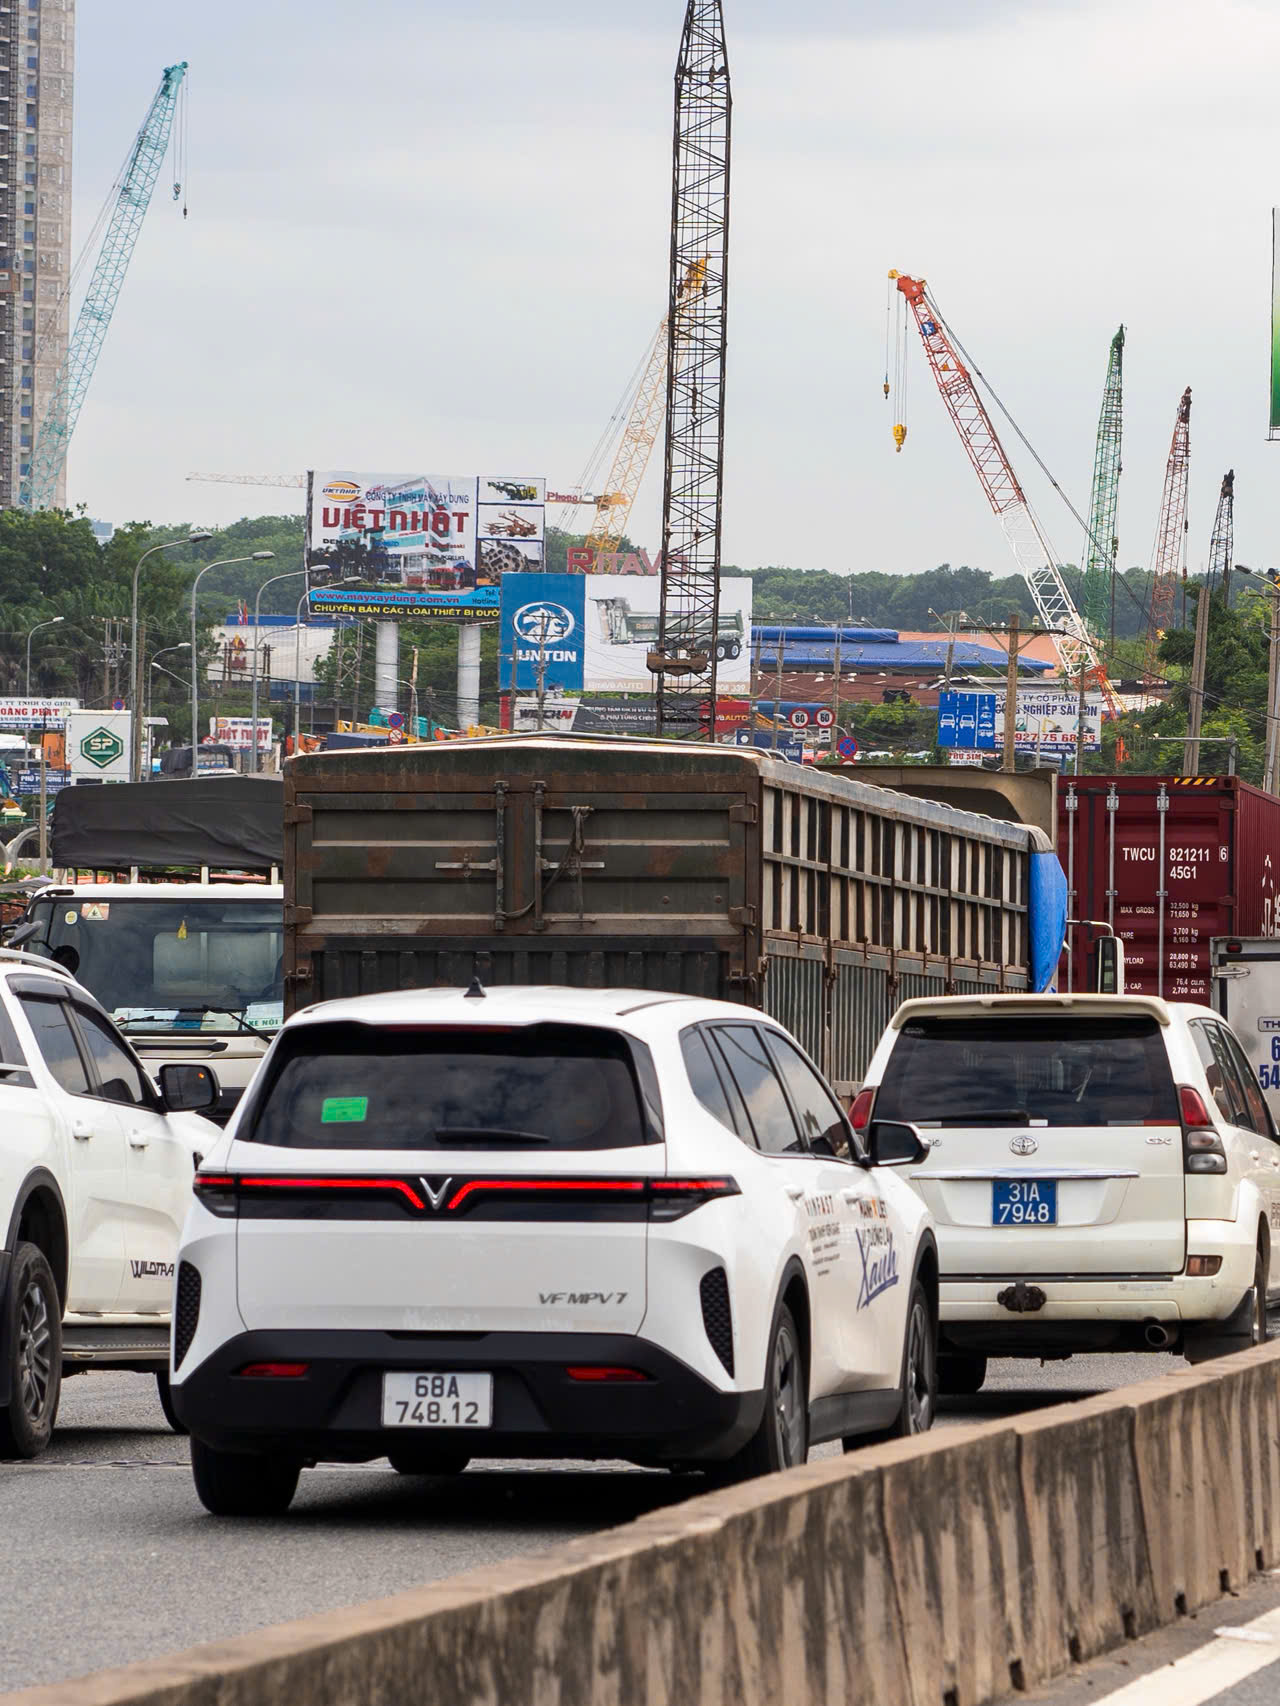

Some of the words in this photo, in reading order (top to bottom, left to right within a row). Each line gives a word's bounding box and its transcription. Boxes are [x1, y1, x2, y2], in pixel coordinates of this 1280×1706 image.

[546, 491, 578, 502] Phong
[314, 604, 356, 614] CHUYÊN
[359, 604, 380, 614] BÁN
[383, 605, 404, 615] CÁC
[407, 607, 431, 616] LOẠI
[434, 607, 461, 616] THIẾT
[464, 609, 474, 618] BỊ
[476, 608, 500, 617] ĐƯỜ
[0, 706, 28, 716] OÀNG
[795, 714, 805, 723] 80
[820, 713, 830, 722] 60
[1014, 732, 1038, 742] 927
[1042, 734, 1057, 742] 75
[90, 738, 113, 750] SP
[1122, 848, 1156, 861] TWCU
[1170, 848, 1210, 862] 821211
[1220, 848, 1228, 861] 6
[1170, 866, 1197, 880] 45G1
[1136, 906, 1155, 914] GROSS
[1173, 928, 1189, 936] 3,700
[1191, 928, 1198, 936] kg
[1190, 953, 1198, 962] kg
[1172, 986, 1188, 994] 2,700
[1008, 1183, 1040, 1202] 31A
[999, 1204, 1050, 1223] 7948
[130, 1260, 175, 1278] WILDTRA
[415, 1375, 460, 1398] 68A
[396, 1401, 478, 1424] 748.12
